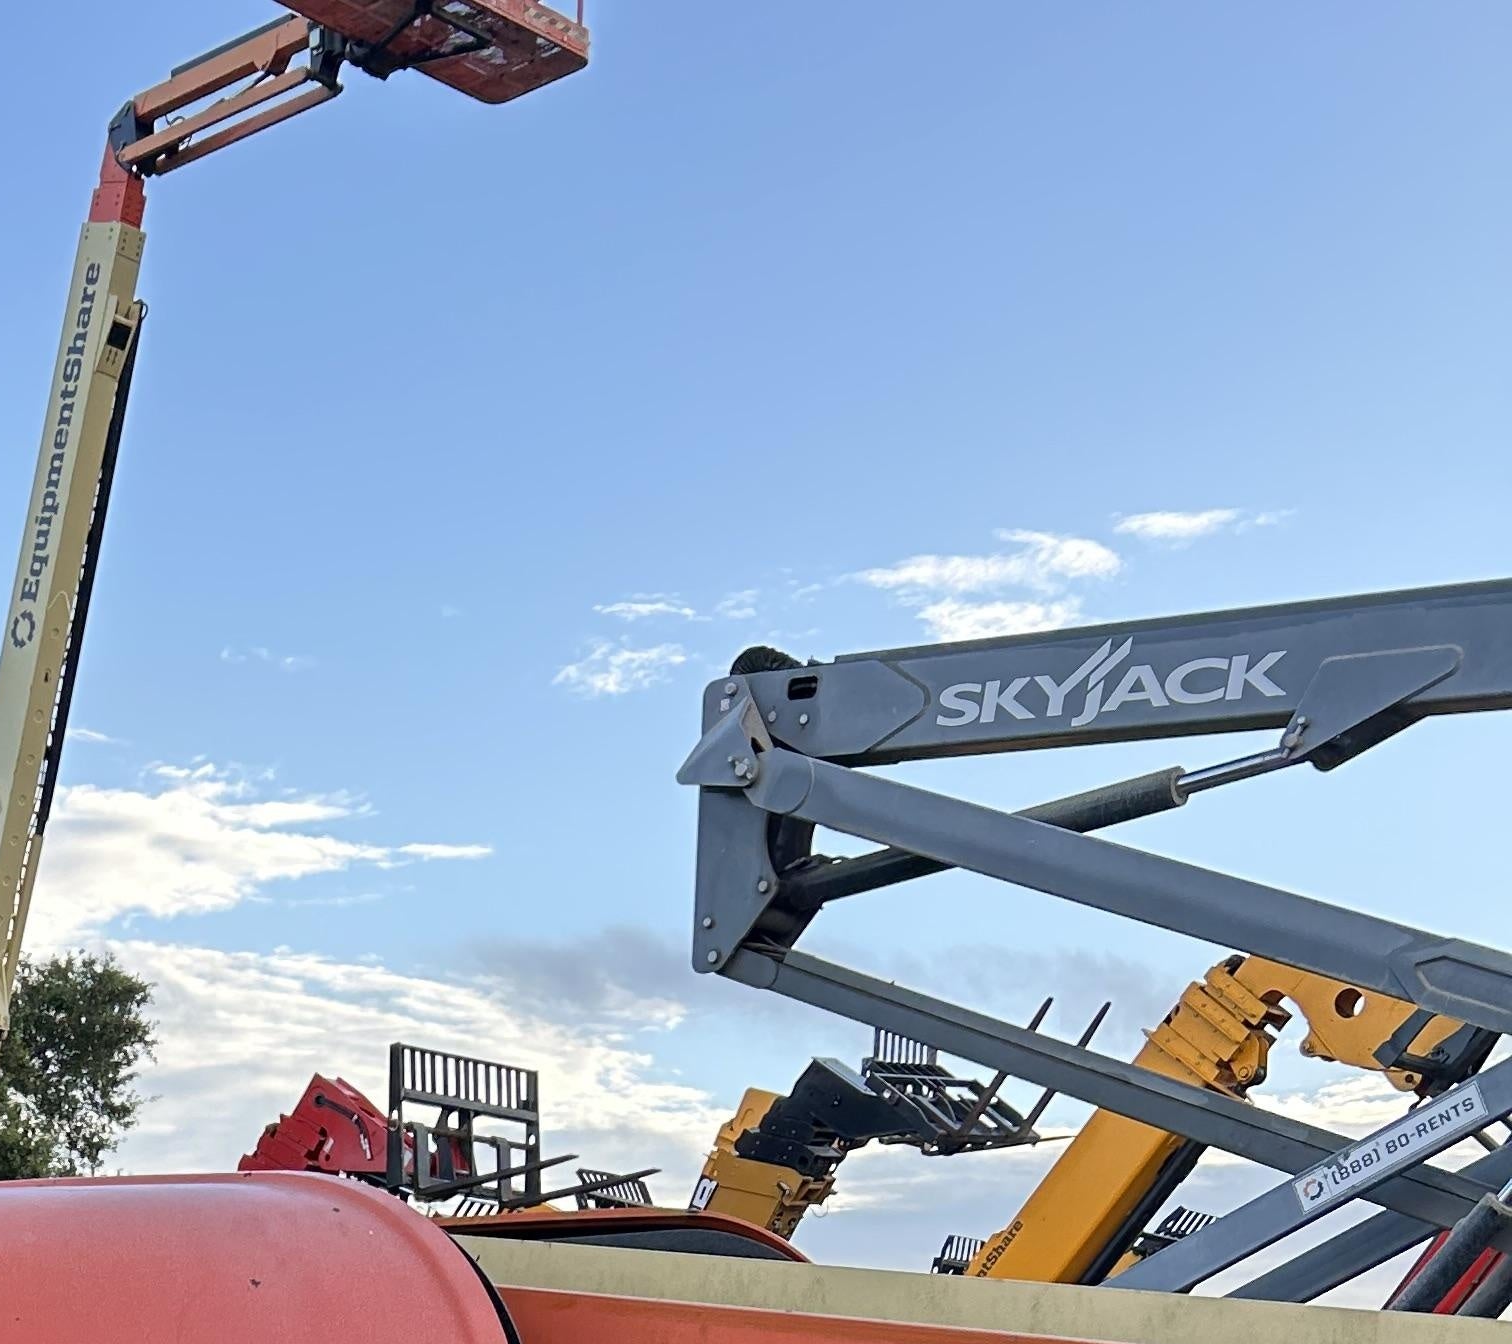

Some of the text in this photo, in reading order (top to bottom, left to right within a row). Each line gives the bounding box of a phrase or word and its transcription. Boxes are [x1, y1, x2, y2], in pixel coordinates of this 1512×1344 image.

[20, 261, 101, 603] EquipmentShare
[936, 636, 1287, 727] SKYJACK
[1331, 1097, 1475, 1185] (888) 80-RENTS
